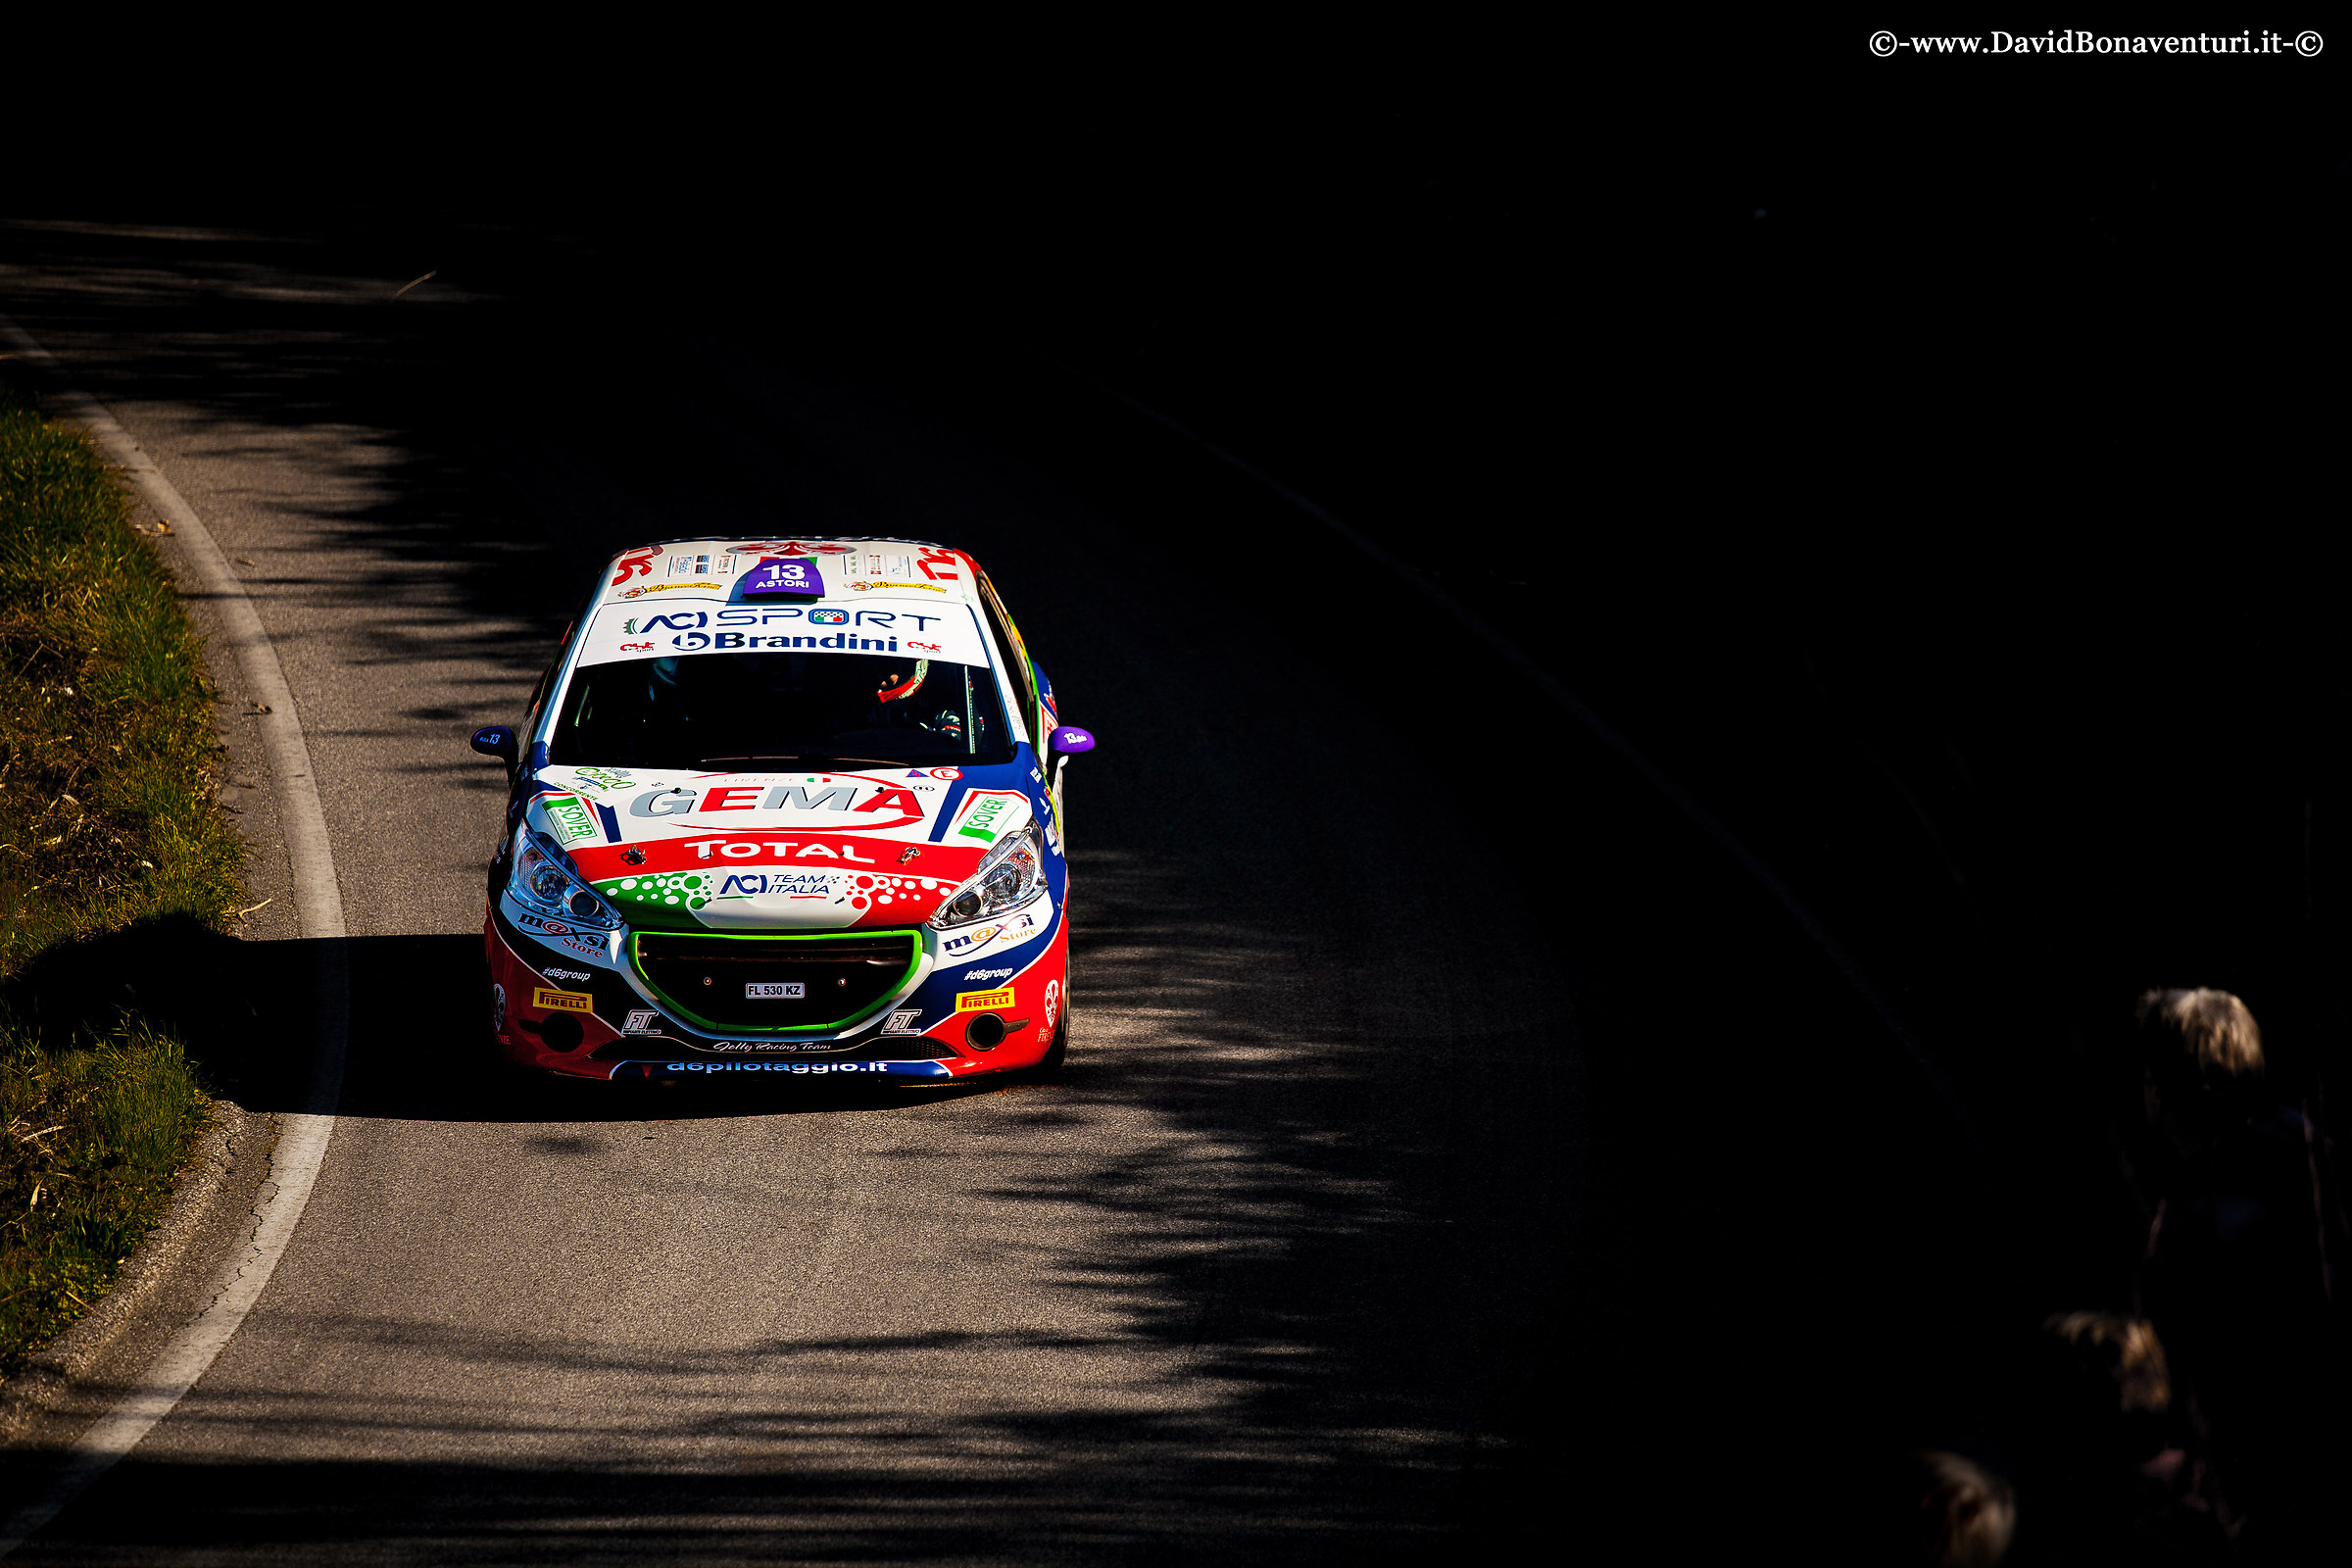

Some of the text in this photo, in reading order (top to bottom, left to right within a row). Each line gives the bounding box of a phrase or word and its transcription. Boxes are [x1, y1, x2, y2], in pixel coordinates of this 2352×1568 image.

[762, 564, 805, 580] 13
[756, 579, 809, 588] ASTORI
[716, 608, 942, 632] SPORT
[714, 633, 898, 653] Brandini
[490, 734, 500, 744] 13
[629, 786, 925, 818] GEMA
[558, 805, 593, 838] SOVER
[968, 799, 1008, 828] SOVER
[684, 840, 875, 863] TOTAL
[719, 874, 826, 894] ACI TEAM
[768, 885, 830, 894] ITALIA
[1000, 928, 1036, 944] Store
[561, 937, 603, 958] Store
[542, 967, 591, 981] #d6group
[964, 968, 1013, 980] #d6group
[748, 986, 801, 996] FL 530 KZ
[539, 991, 588, 1009] PIRELLI
[961, 992, 1010, 1008] PIRELLI
[713, 1041, 753, 1053] Jolly
[756, 1042, 797, 1052] Racing
[666, 1062, 888, 1074] d6pilotaggio.it
